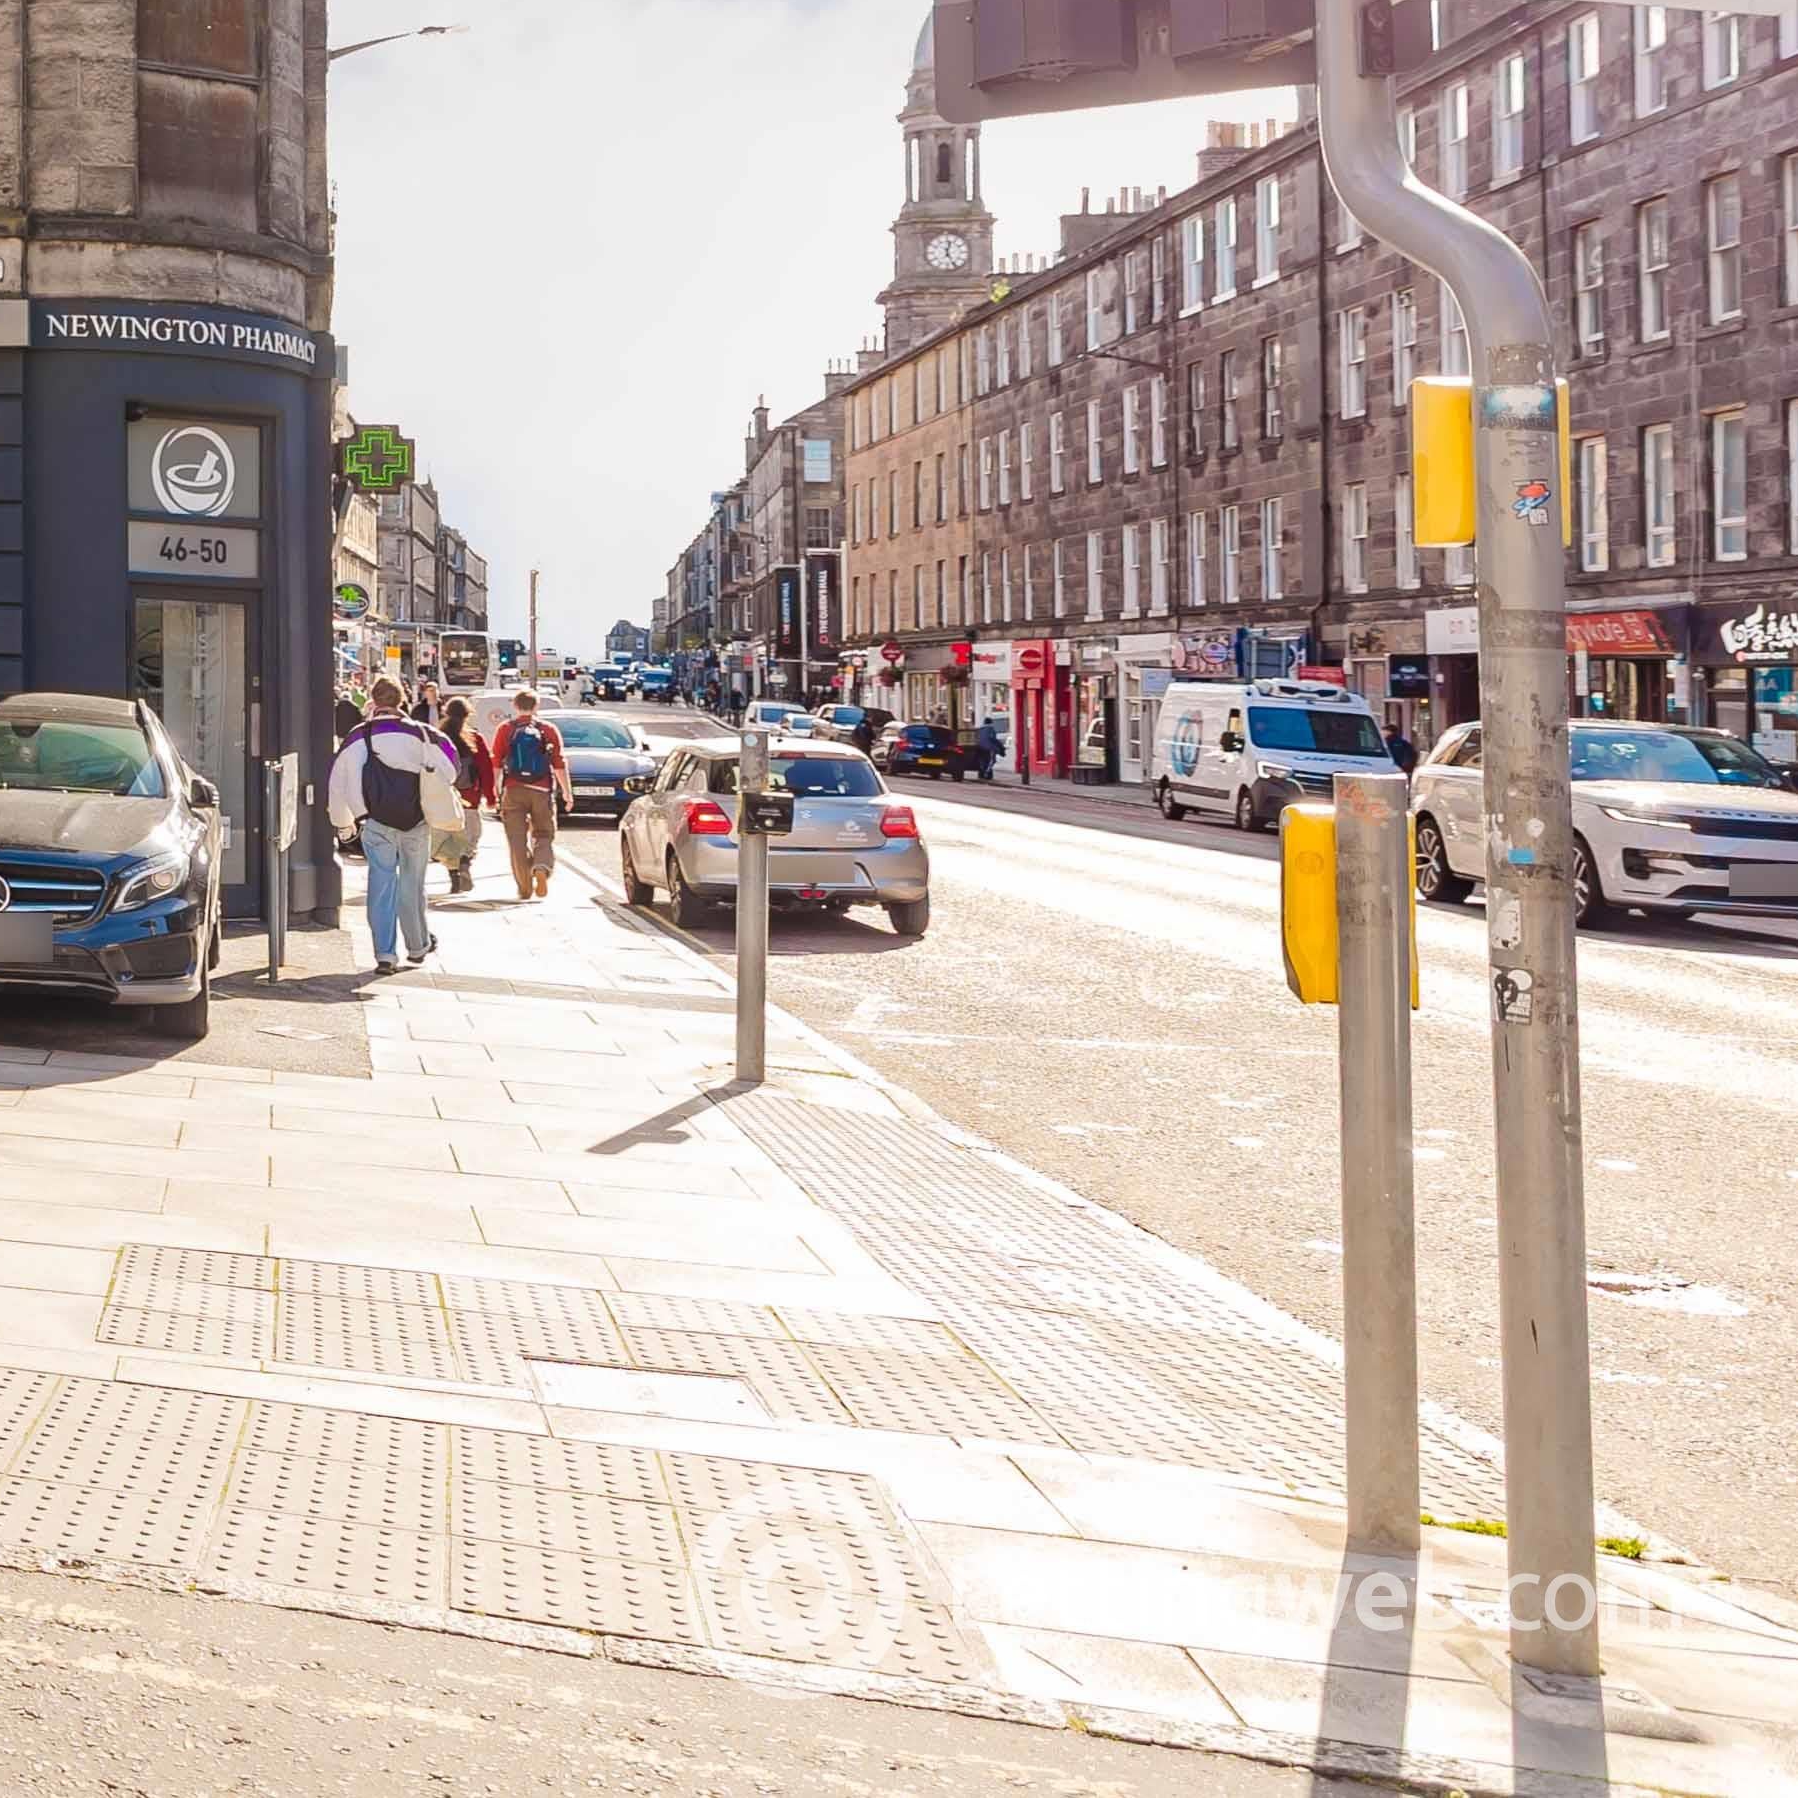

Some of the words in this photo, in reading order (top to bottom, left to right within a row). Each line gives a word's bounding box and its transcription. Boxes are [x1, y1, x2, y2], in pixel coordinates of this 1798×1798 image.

[46, 314, 227, 346] NEWINGTON
[232, 325, 317, 364] PHARMACY
[159, 537, 227, 564] 46-50
